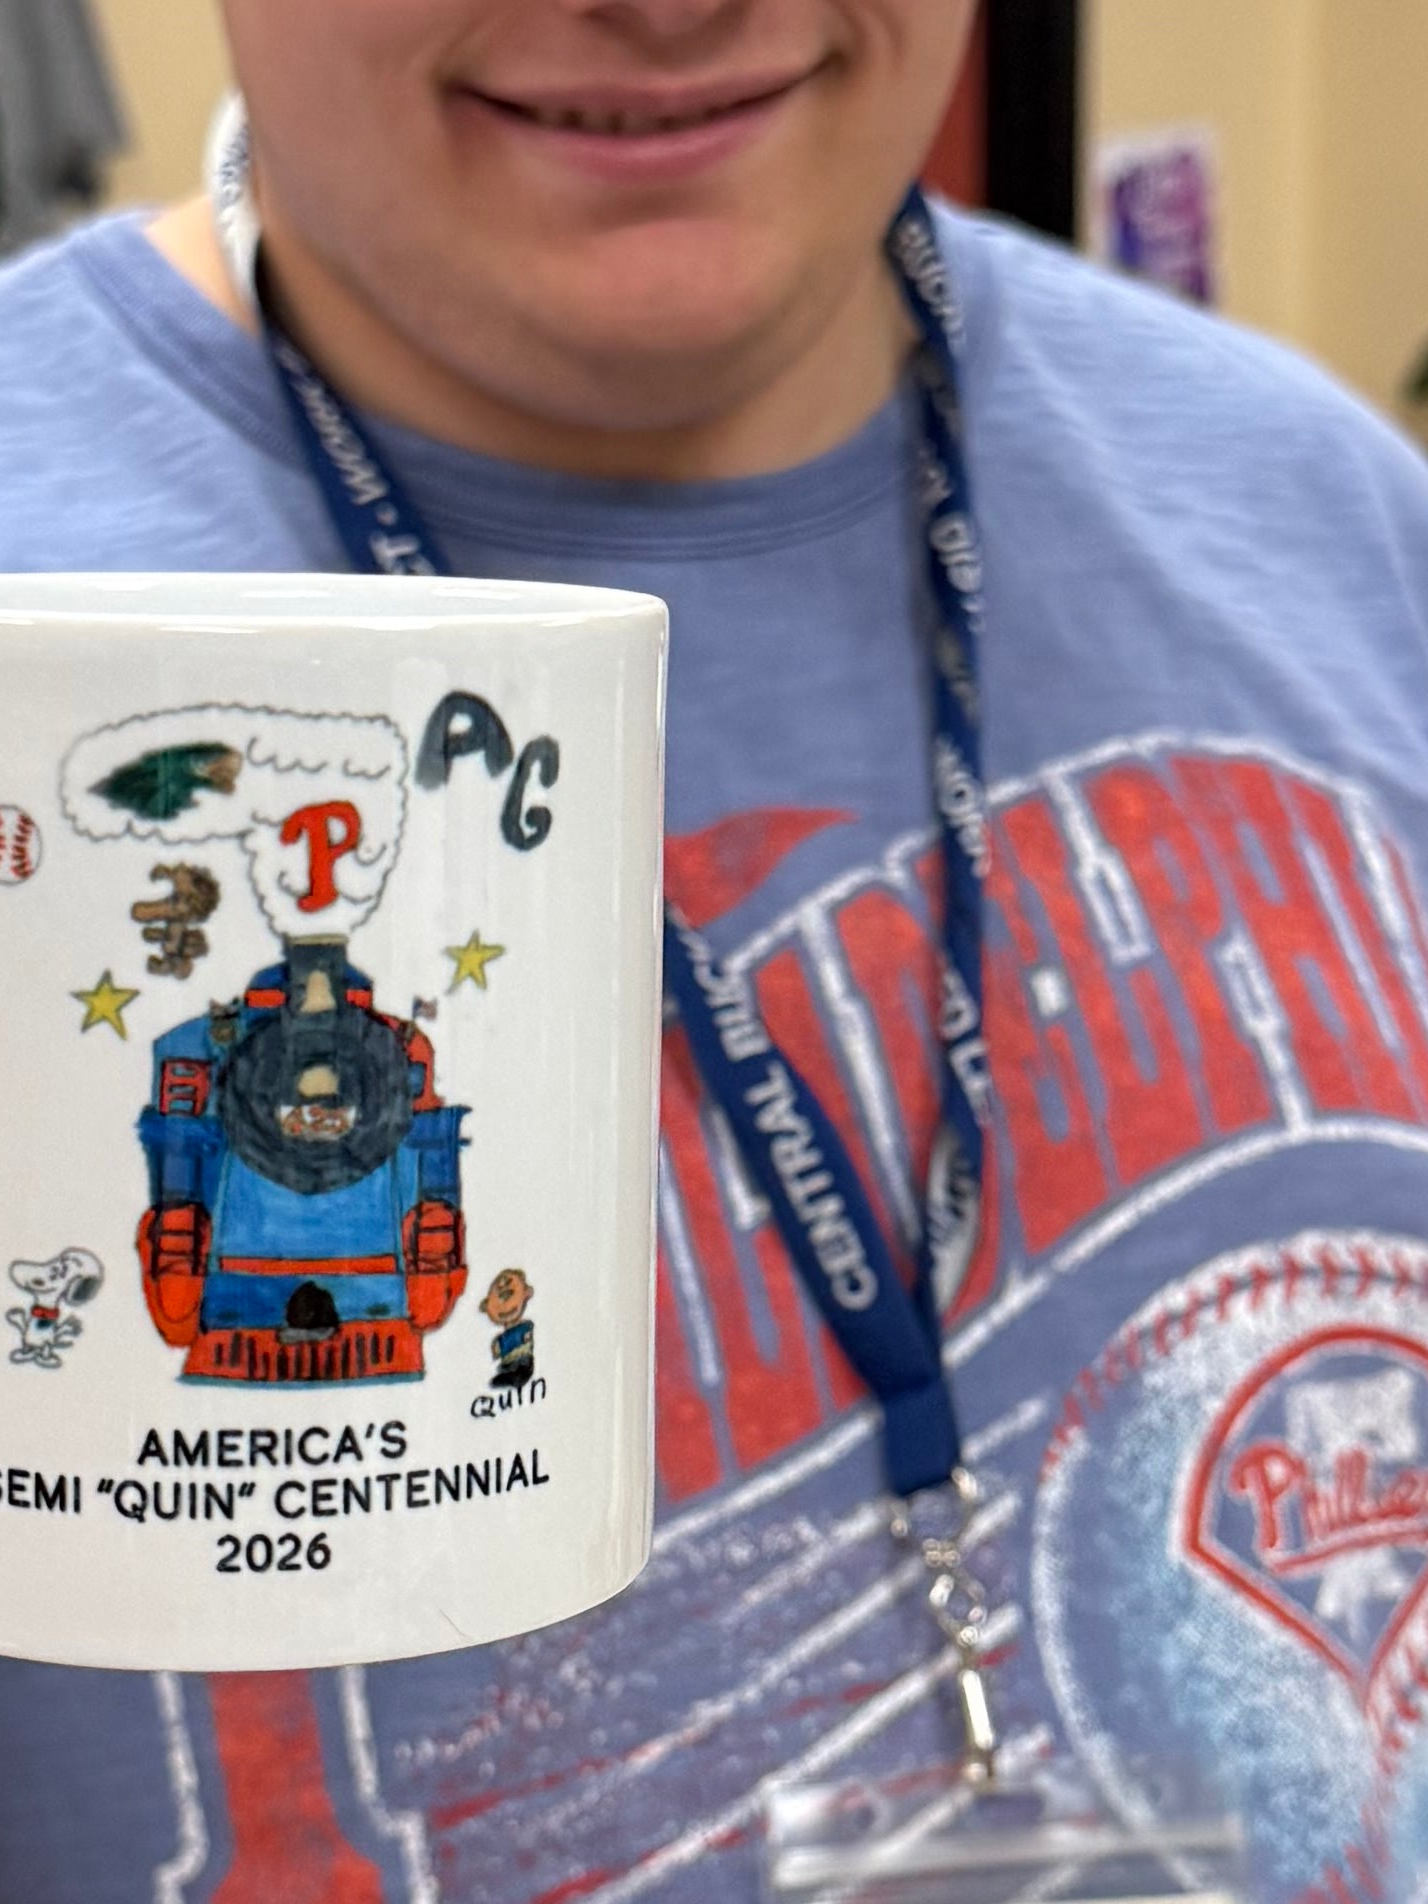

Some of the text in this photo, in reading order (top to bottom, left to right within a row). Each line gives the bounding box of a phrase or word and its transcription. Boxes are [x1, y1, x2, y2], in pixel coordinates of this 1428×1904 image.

[279, 800, 362, 914] P
[743, 1060, 879, 1311] CENTRAL
[137, 1419, 408, 1468] AMERICA'S
[274, 1449, 550, 1519] CENTENNIAL
[216, 1532, 332, 1573] 2026
